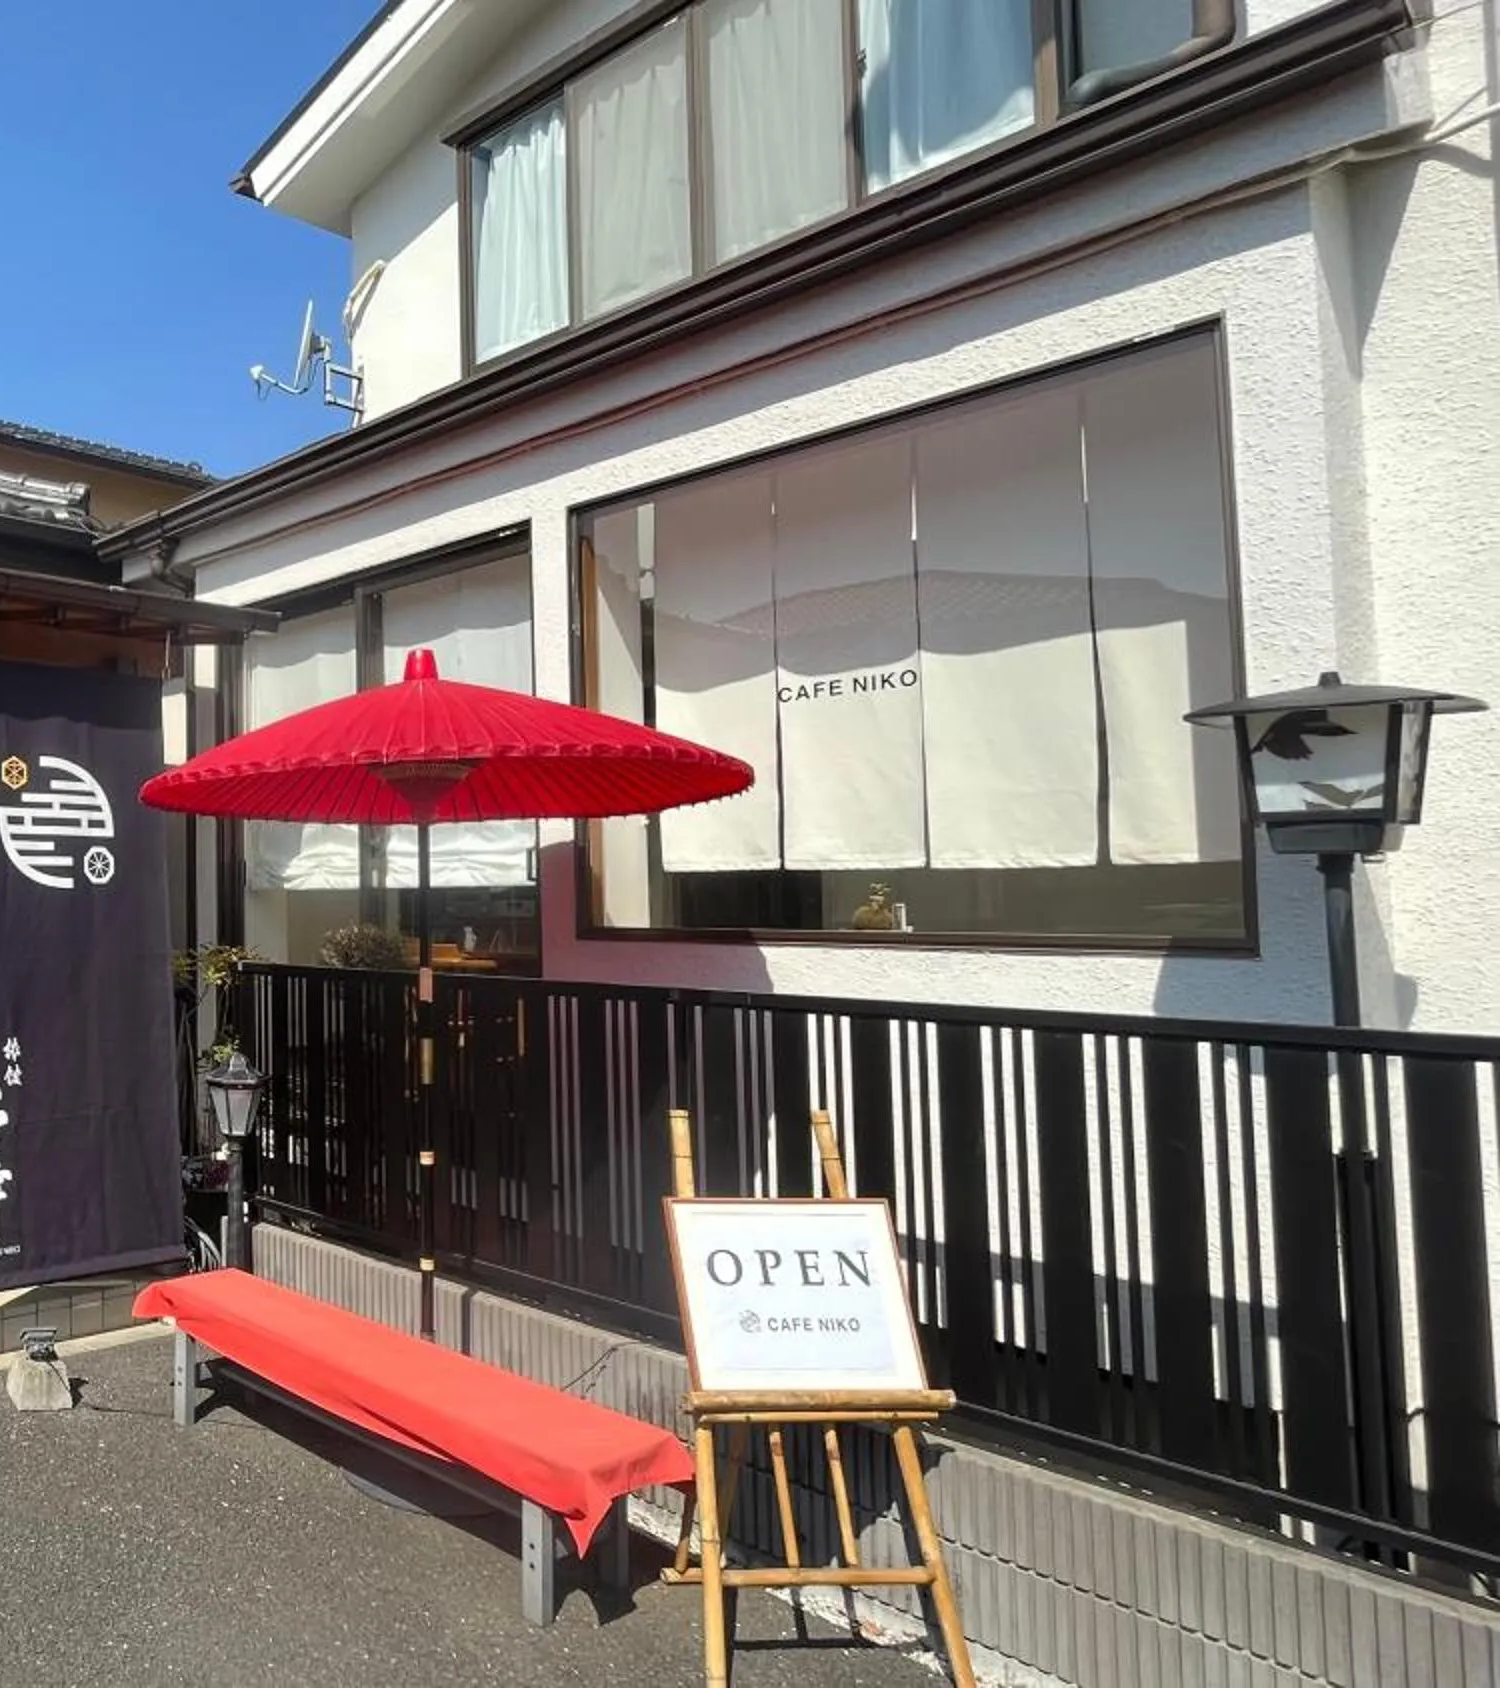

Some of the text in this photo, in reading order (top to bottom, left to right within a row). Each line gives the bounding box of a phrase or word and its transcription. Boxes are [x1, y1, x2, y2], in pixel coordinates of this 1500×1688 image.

[777, 669, 918, 703] CAFE NIKO
[707, 1249, 872, 1287] OPEN
[767, 1317, 861, 1332] CAFE NIKO
